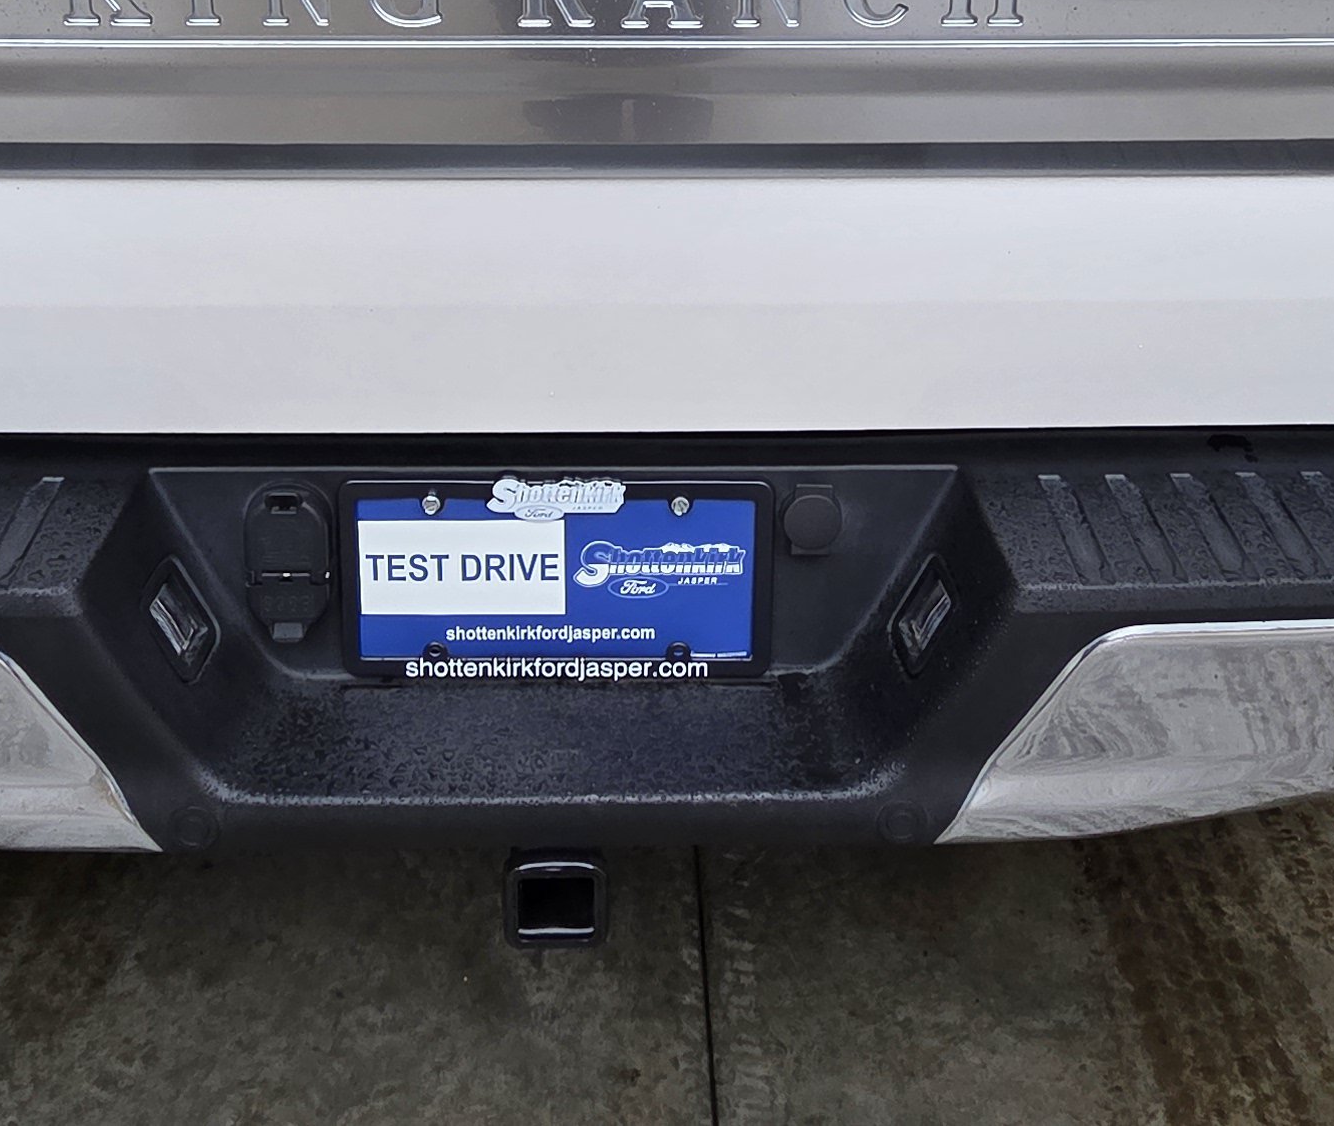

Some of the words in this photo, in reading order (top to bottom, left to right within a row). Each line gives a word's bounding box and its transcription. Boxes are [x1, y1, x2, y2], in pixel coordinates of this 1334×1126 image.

[487, 479, 626, 513] Shottenkirk
[524, 508, 554, 518] Ford
[365, 554, 449, 581] TEST
[461, 554, 560, 581] DRIVE
[574, 541, 746, 587] Shottenkirk
[619, 579, 656, 595] Ford
[677, 576, 718, 585] JASPER
[445, 625, 656, 643] shottenkirkfordjasper.com
[405, 657, 709, 681] shottenkirkfordjasper.com
